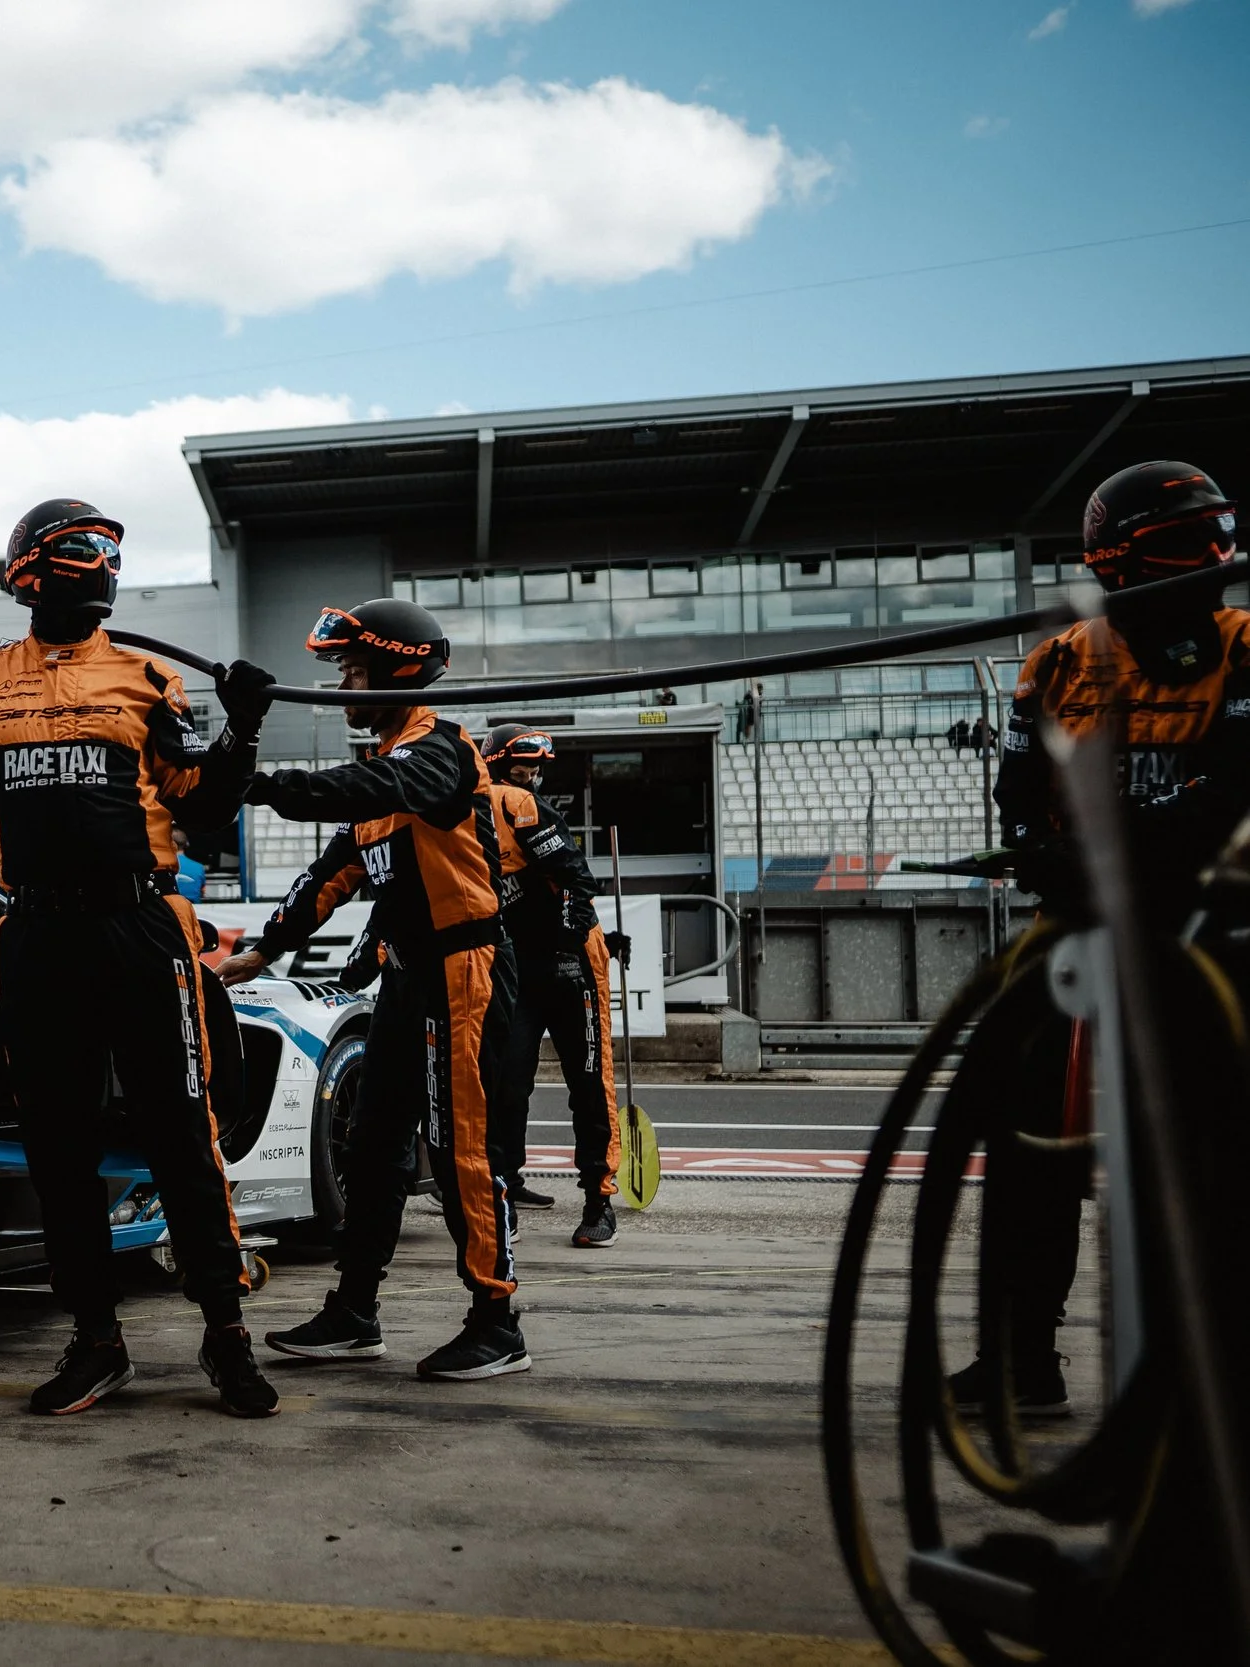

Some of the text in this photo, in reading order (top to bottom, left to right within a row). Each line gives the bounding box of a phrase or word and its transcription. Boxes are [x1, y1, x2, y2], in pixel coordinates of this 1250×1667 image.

[358, 631, 432, 656] RUROC
[4, 745, 107, 780] RACETAXI
[5, 772, 108, 791] under8.de
[173, 958, 199, 1098] GETSPEED
[426, 1017, 440, 1149] GETSPEED
[259, 1147, 305, 1162] INSCRIPTA
[240, 1186, 304, 1203] GETSPEED
